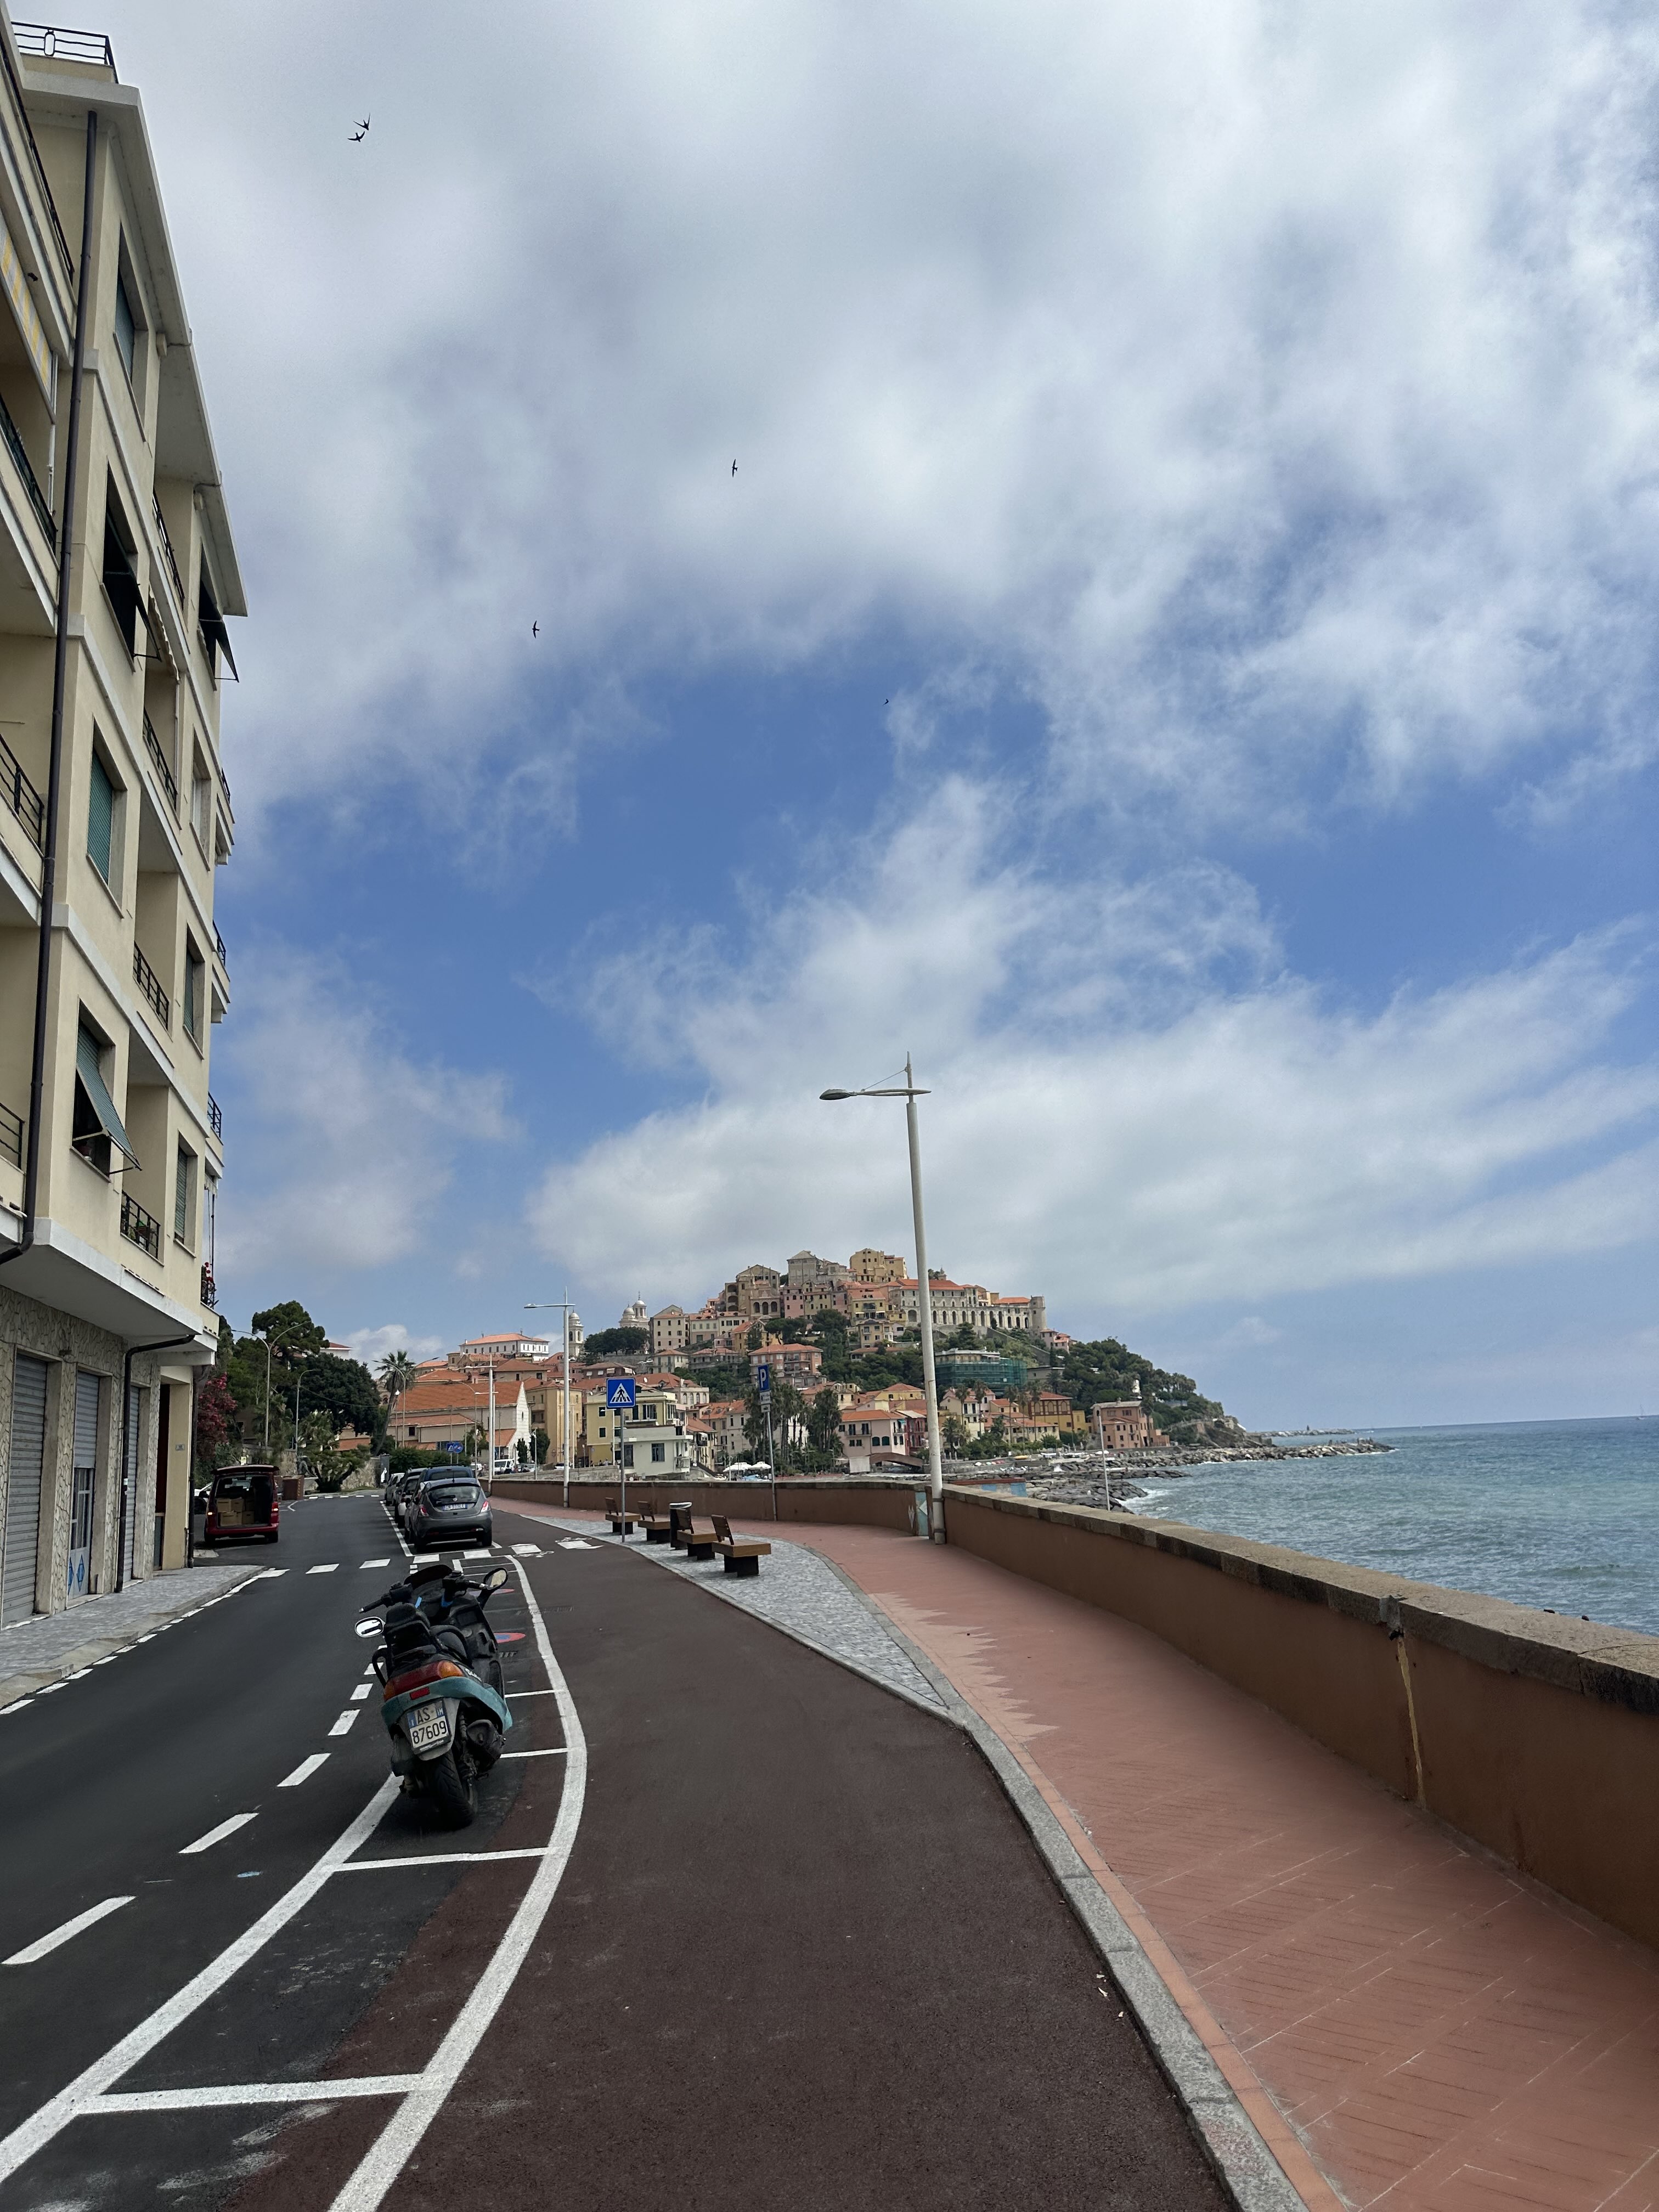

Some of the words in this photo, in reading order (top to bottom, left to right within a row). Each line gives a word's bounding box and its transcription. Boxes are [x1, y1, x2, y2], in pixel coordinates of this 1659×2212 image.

[760, 1368, 766, 1389] P
[417, 1707, 431, 1724] AS
[412, 1720, 447, 1744] 87609
